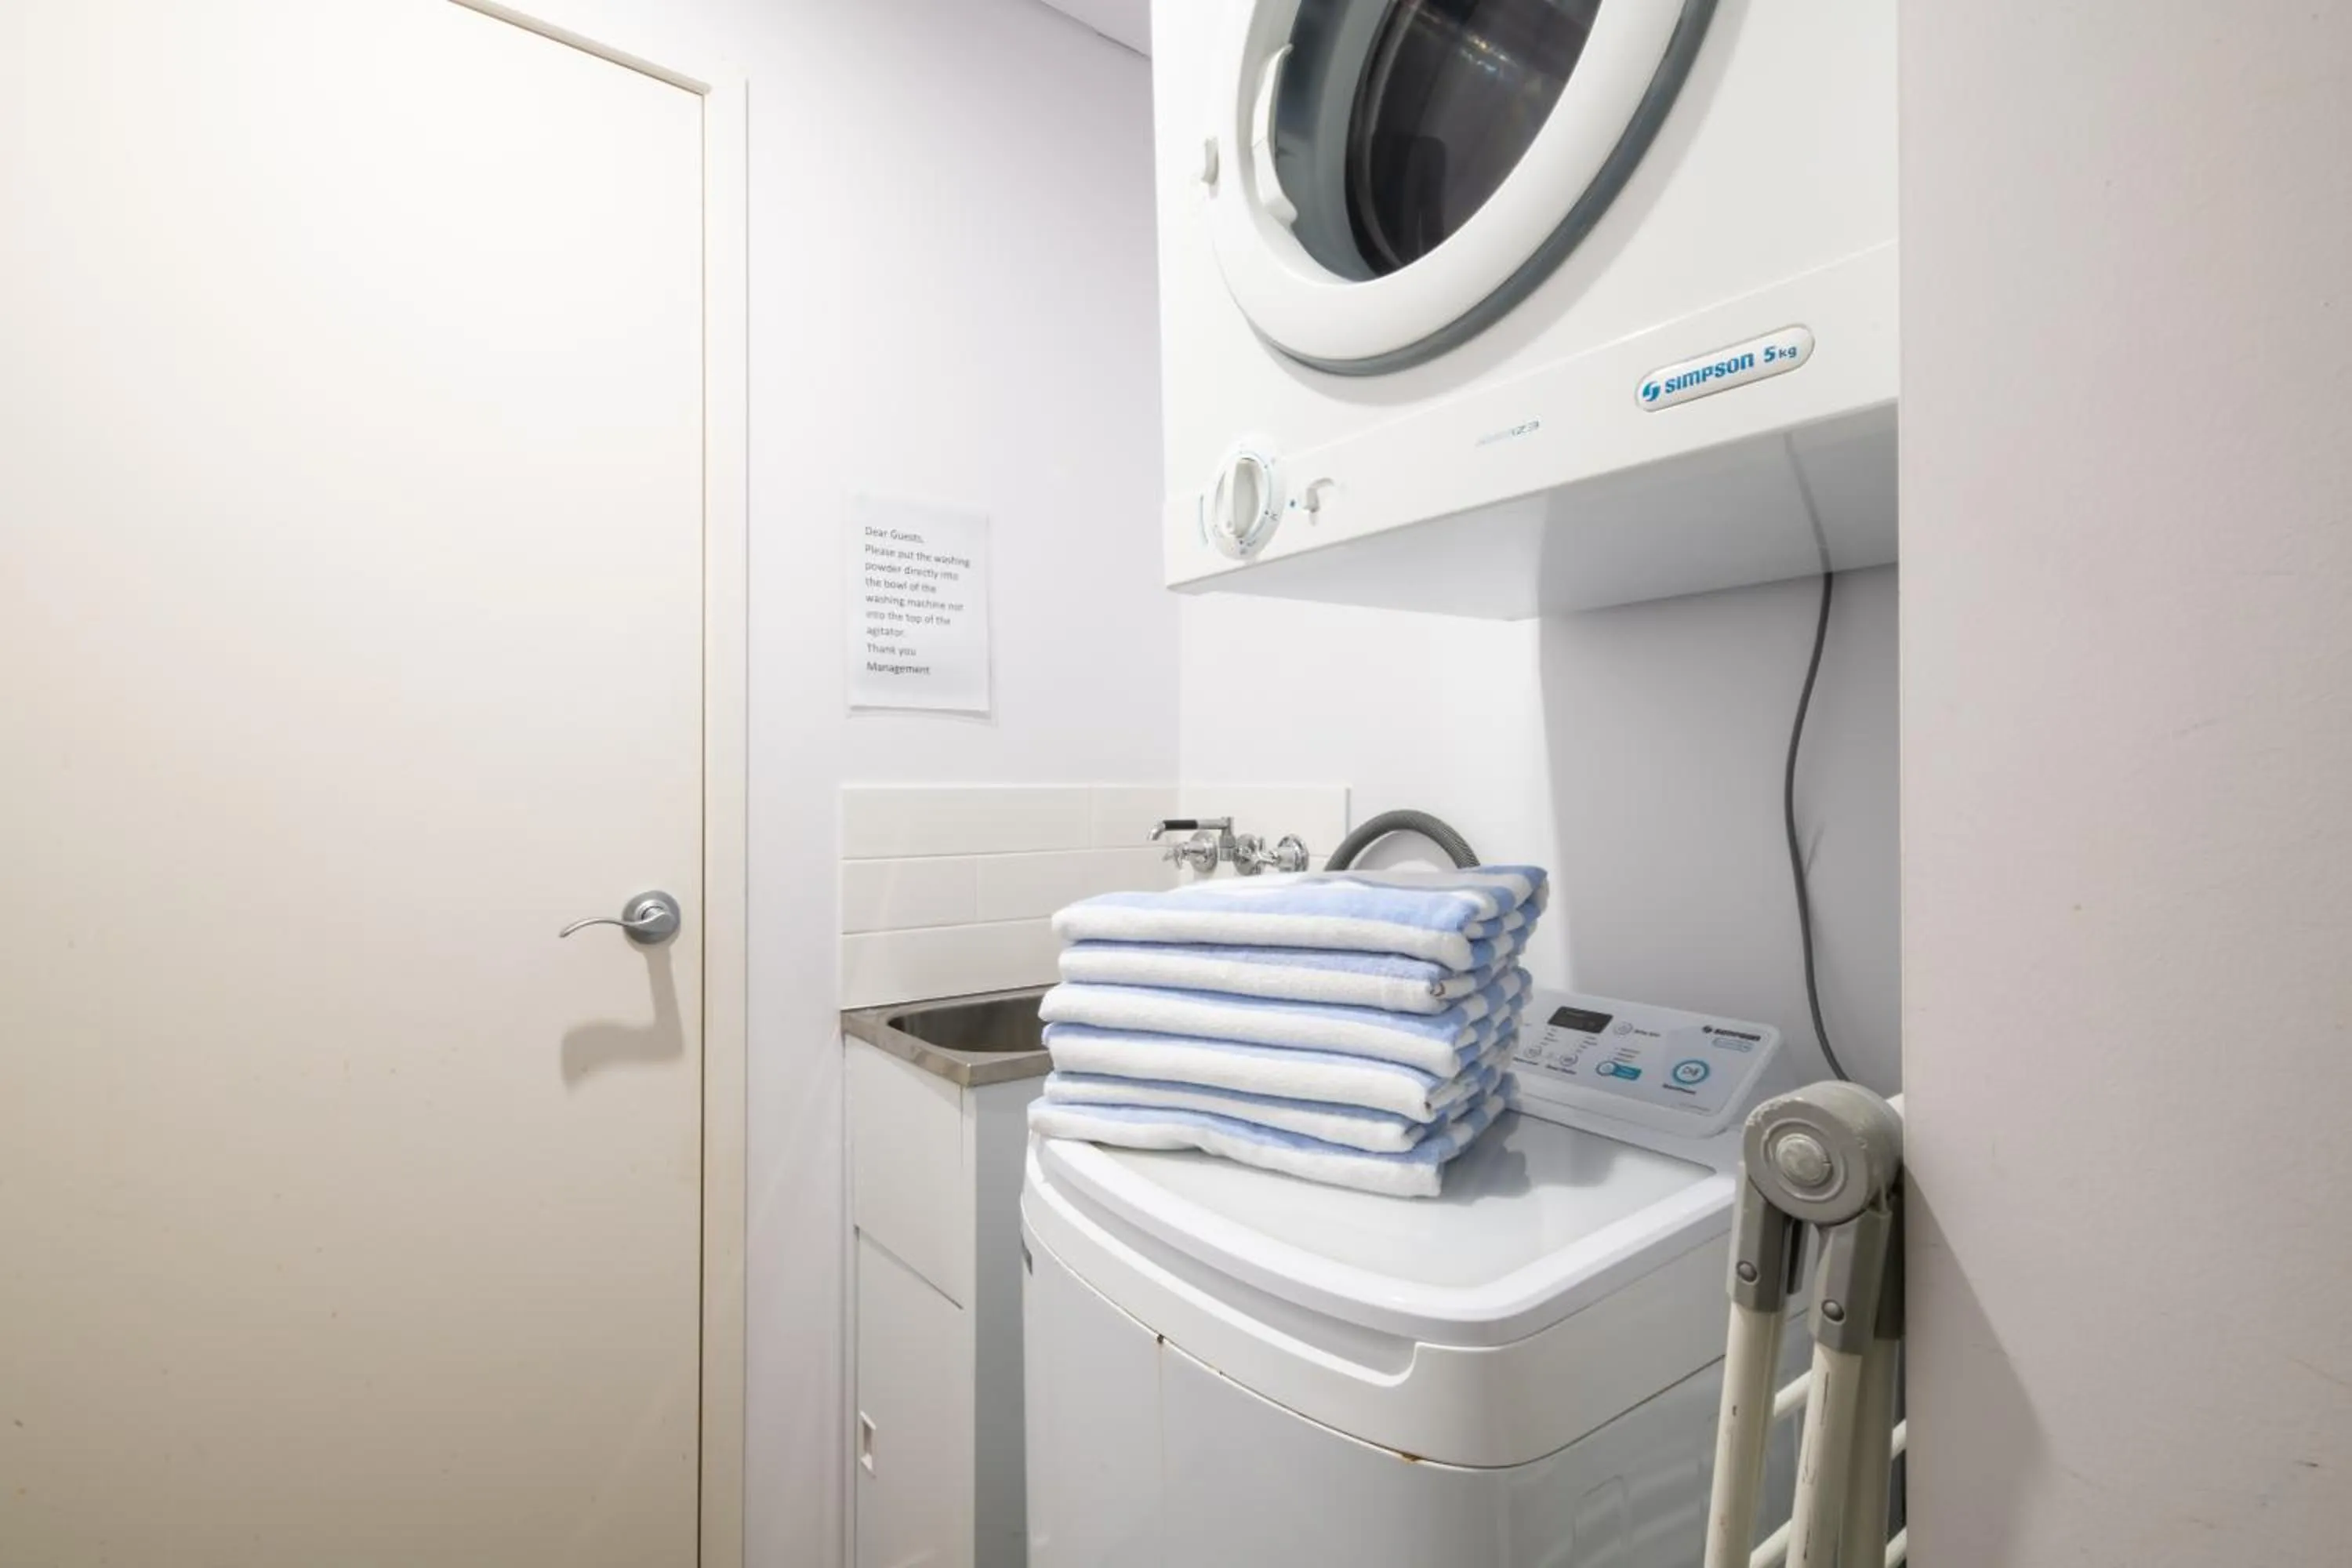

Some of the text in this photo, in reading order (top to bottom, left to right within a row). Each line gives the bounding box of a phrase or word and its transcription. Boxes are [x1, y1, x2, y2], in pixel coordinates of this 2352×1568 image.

[1664, 352, 1755, 394] SIMPSON
[865, 526, 924, 543] Dear Guests,
[865, 544, 971, 568] Please put the washing
[865, 562, 960, 582] powder directly into
[865, 576, 938, 594] the bowl of the
[865, 594, 964, 612] washing machine not
[866, 609, 951, 626] into the top of the
[866, 643, 917, 658] Thank you
[866, 661, 931, 675] Management
